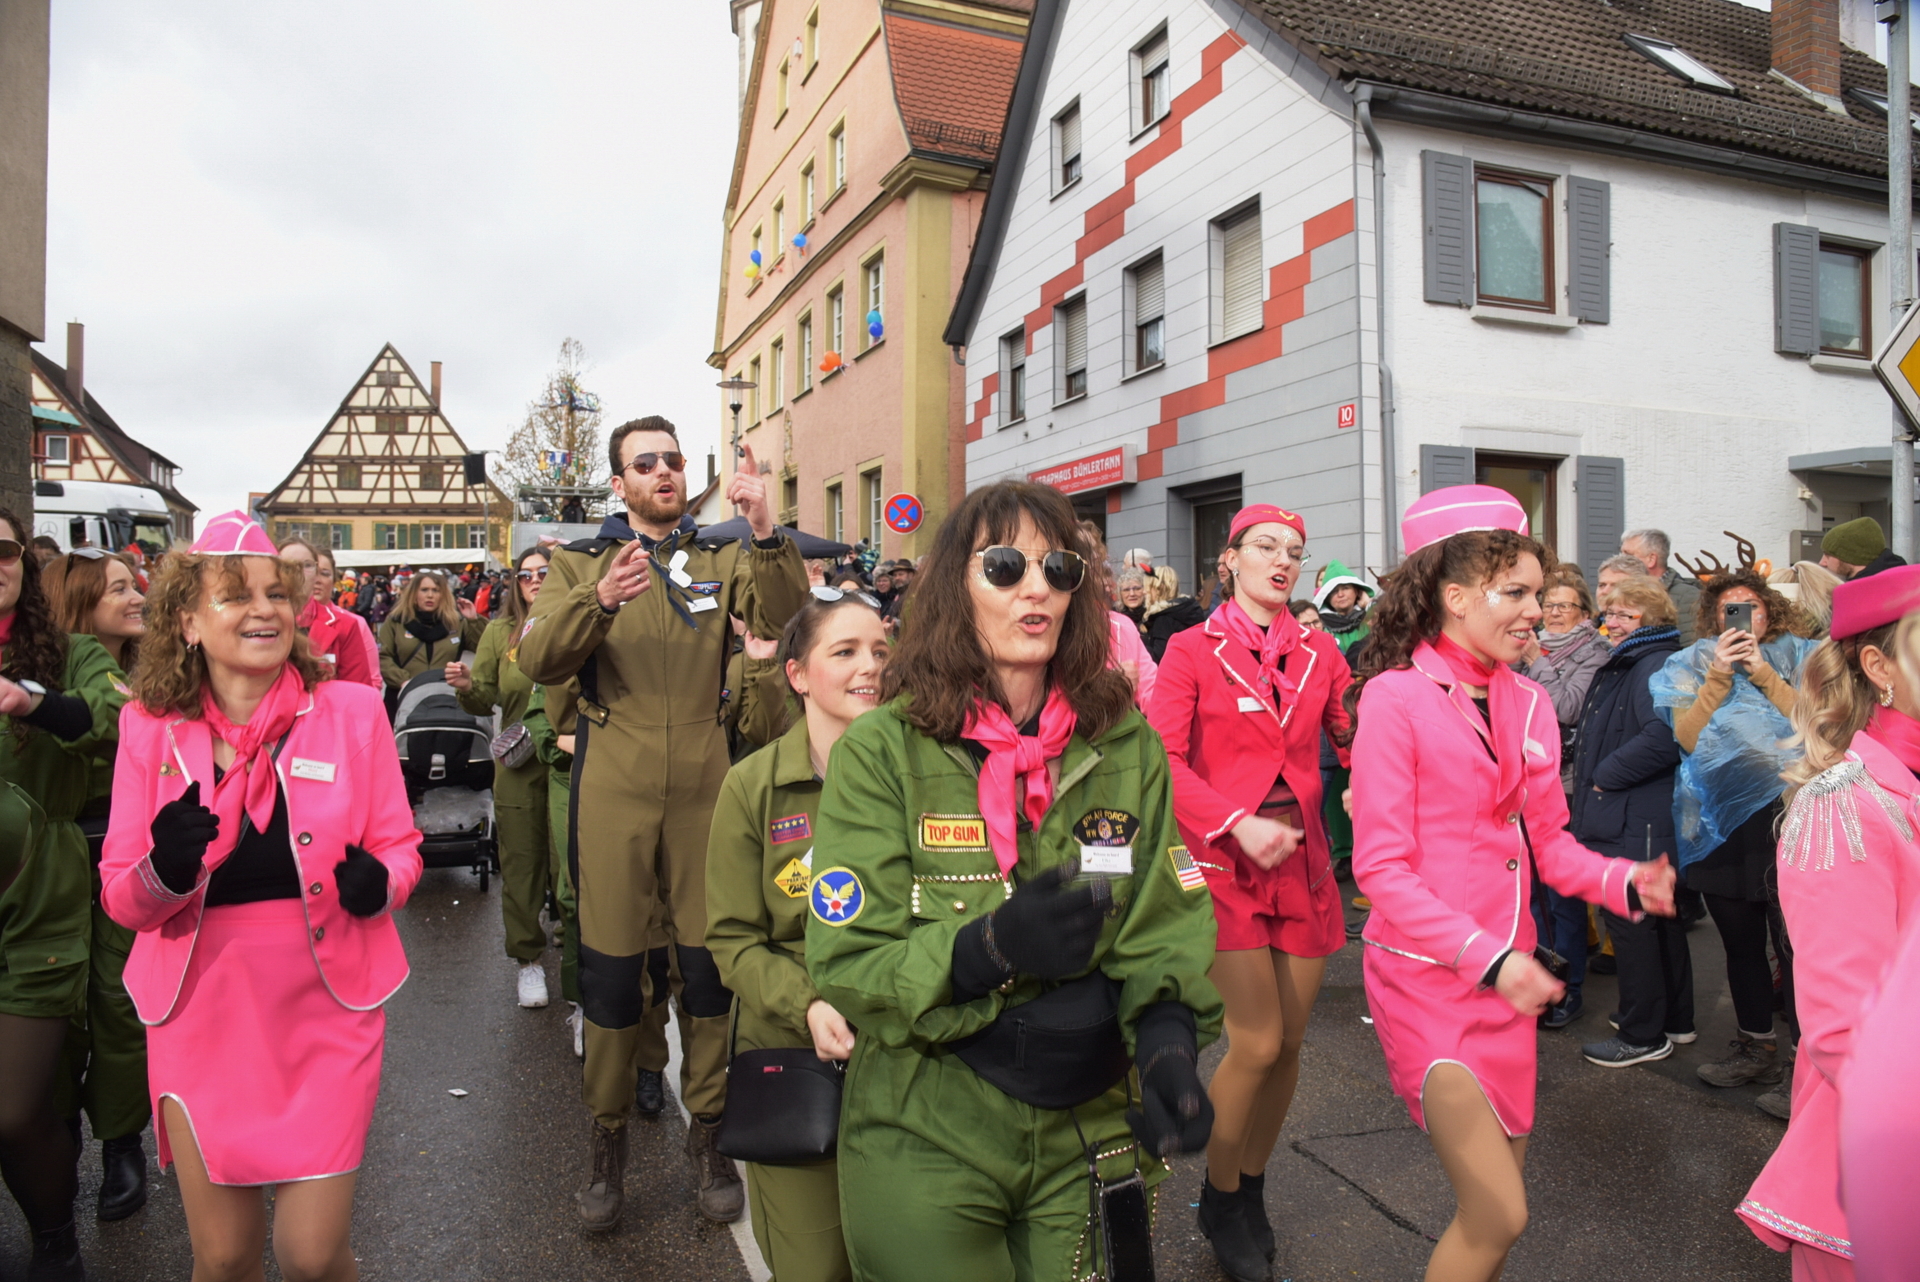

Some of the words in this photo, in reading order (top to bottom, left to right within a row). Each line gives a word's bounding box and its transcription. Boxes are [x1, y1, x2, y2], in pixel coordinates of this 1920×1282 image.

[1341, 406, 1352, 422] 10
[1073, 454, 1121, 478] BÜHLERTANN
[1104, 810, 1129, 823] FORCE
[927, 824, 951, 841] TOP
[953, 825, 980, 841] GUN
[1085, 828, 1097, 838] WW
